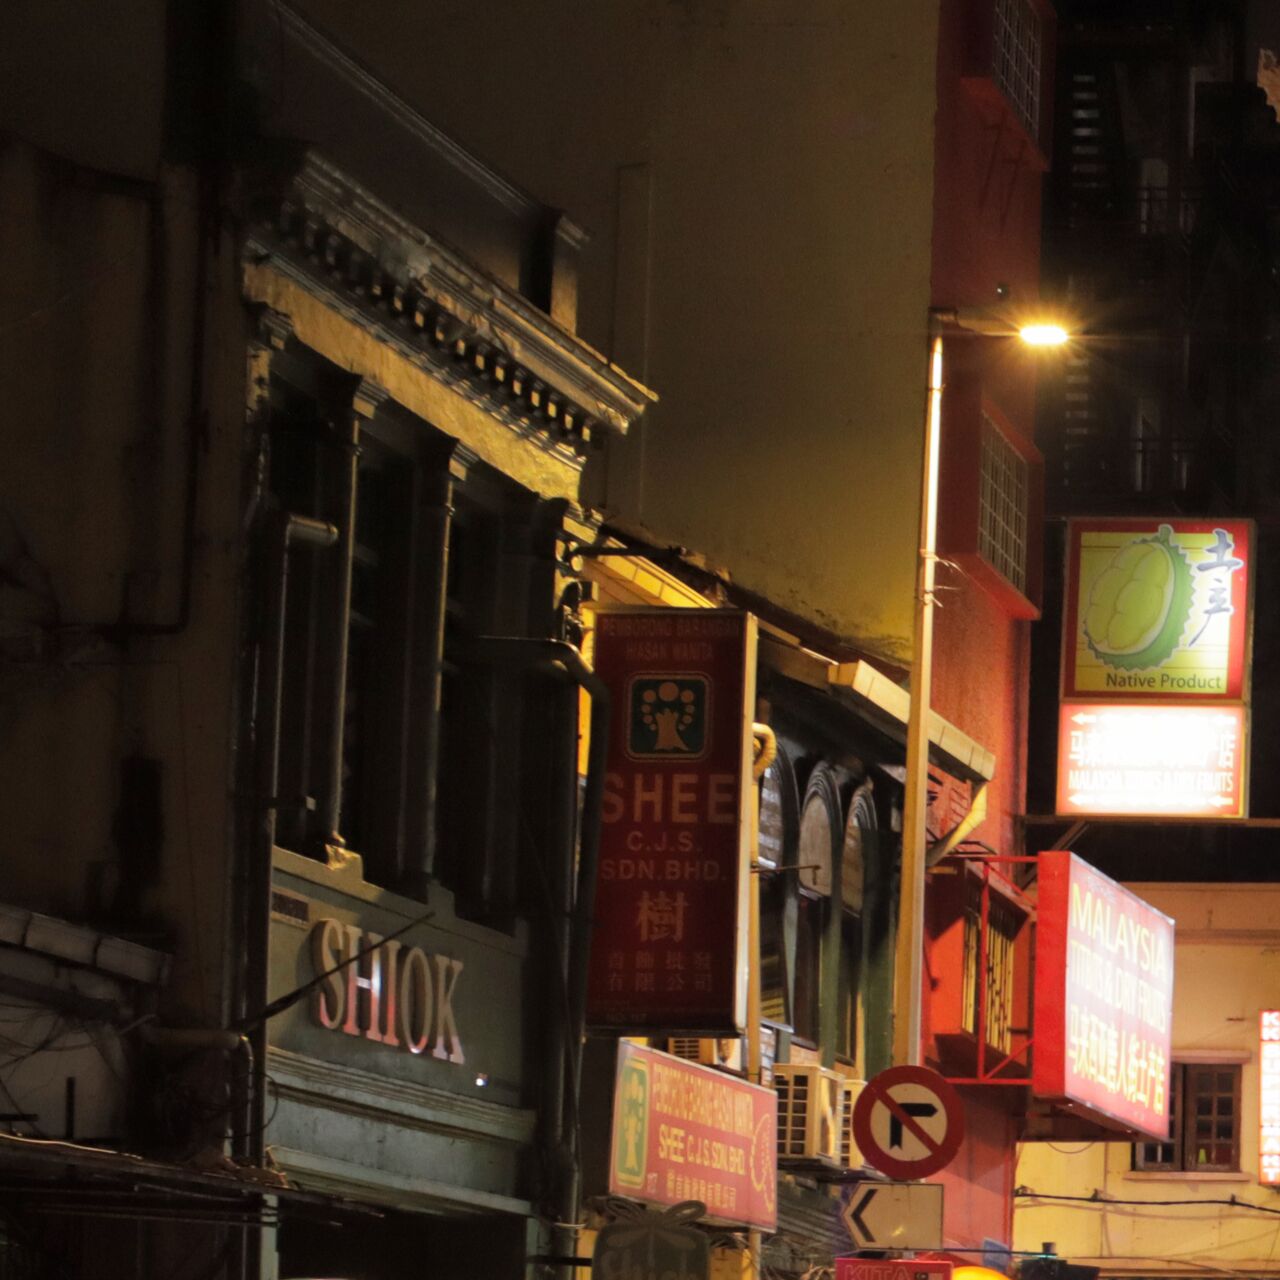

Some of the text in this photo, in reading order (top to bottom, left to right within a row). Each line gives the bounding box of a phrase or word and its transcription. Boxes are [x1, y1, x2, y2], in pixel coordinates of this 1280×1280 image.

[1105, 673, 1222, 690] Native Product
[601, 773, 736, 824] SHEE
[626, 830, 703, 852] C.J.S.
[636, 891, 689, 943] 樹
[1071, 882, 1168, 984] MALAYSIA
[316, 917, 465, 1065] SHIOK
[607, 972, 713, 993] 有限公司
[658, 1123, 686, 1164] SHEE
